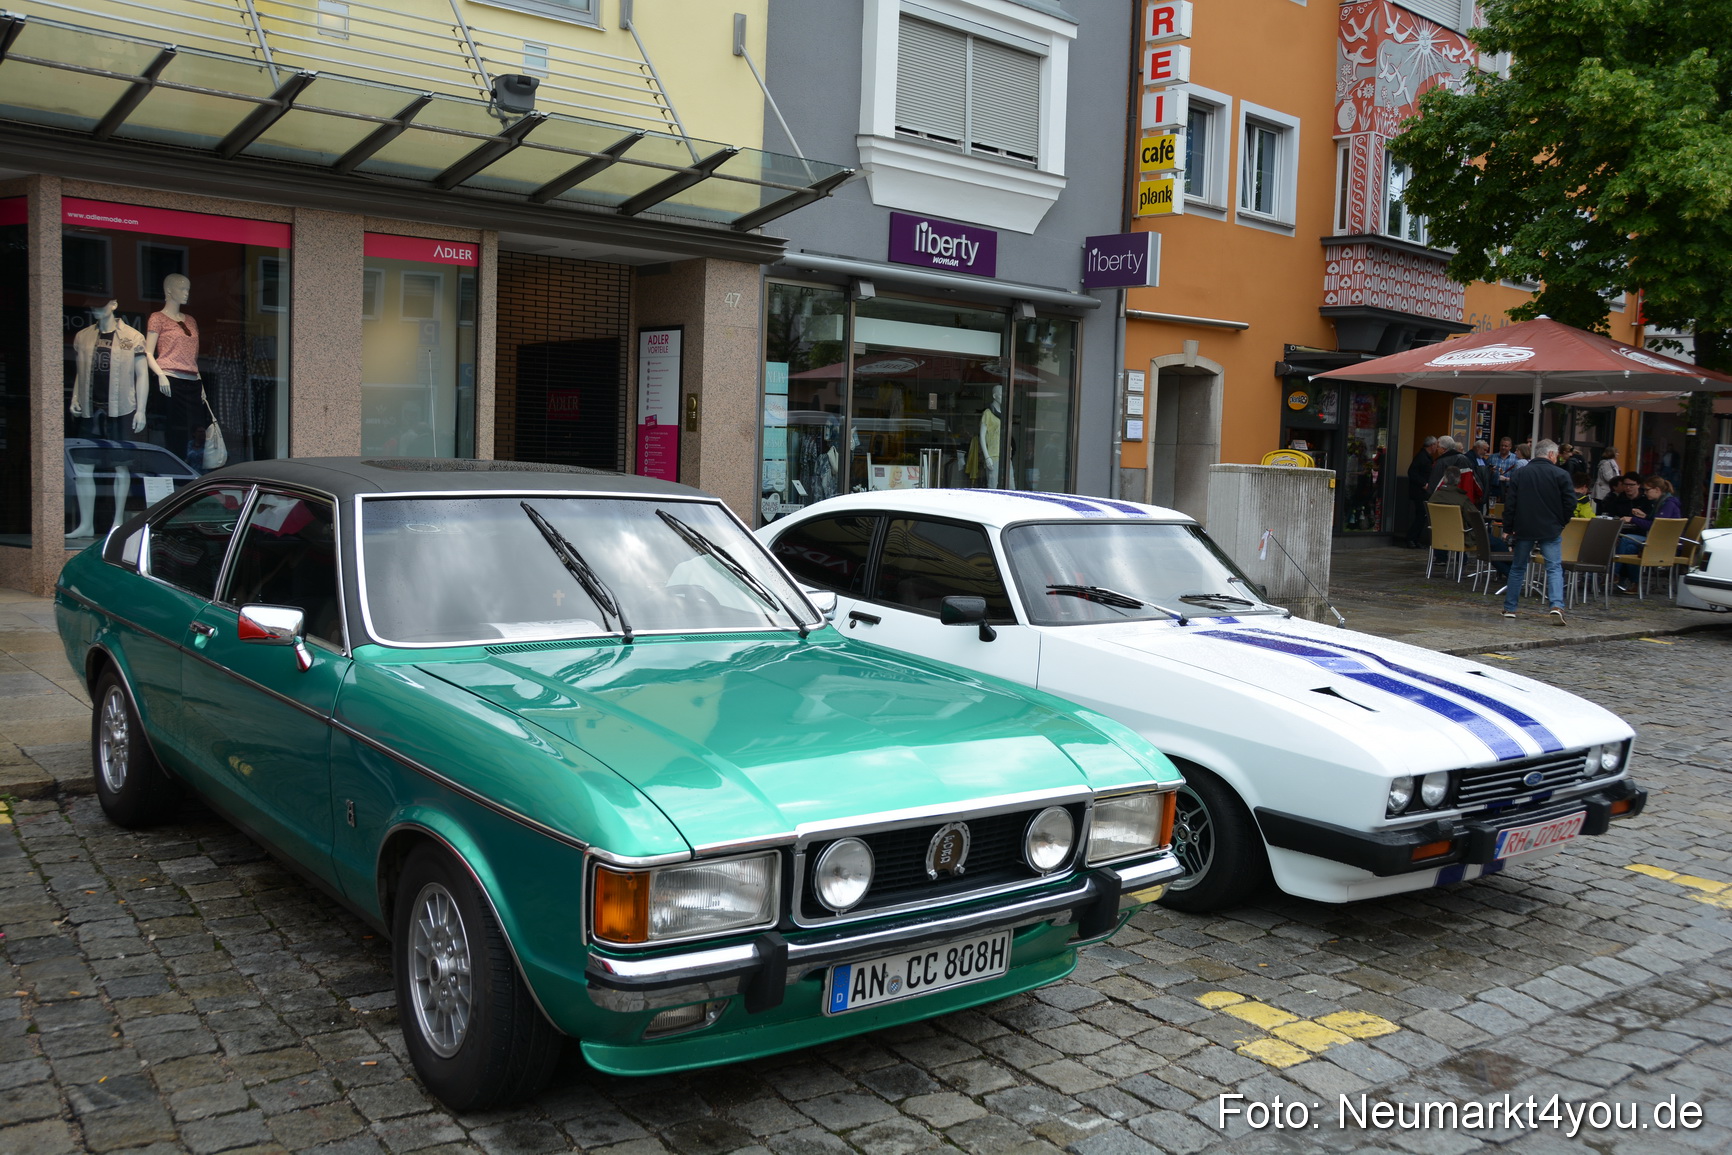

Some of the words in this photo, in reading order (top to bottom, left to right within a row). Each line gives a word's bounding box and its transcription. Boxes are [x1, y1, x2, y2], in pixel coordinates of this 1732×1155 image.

[1142, 139, 1174, 164] café
[1139, 185, 1172, 210] plank
[67, 212, 139, 225] www.adlermode.com
[433, 245, 473, 260] ADLER
[914, 221, 980, 266] liberty
[932, 256, 959, 267] woman
[1088, 248, 1144, 274] liberty
[724, 292, 741, 308] 47
[648, 334, 669, 345] ADLER
[648, 346, 669, 354] VORTEILE
[940, 835, 956, 864] FORD
[1503, 830, 1532, 854] RH
[851, 962, 888, 1003] AN
[906, 951, 939, 989] CC
[944, 936, 1006, 980] 808H
[836, 992, 844, 1003] D
